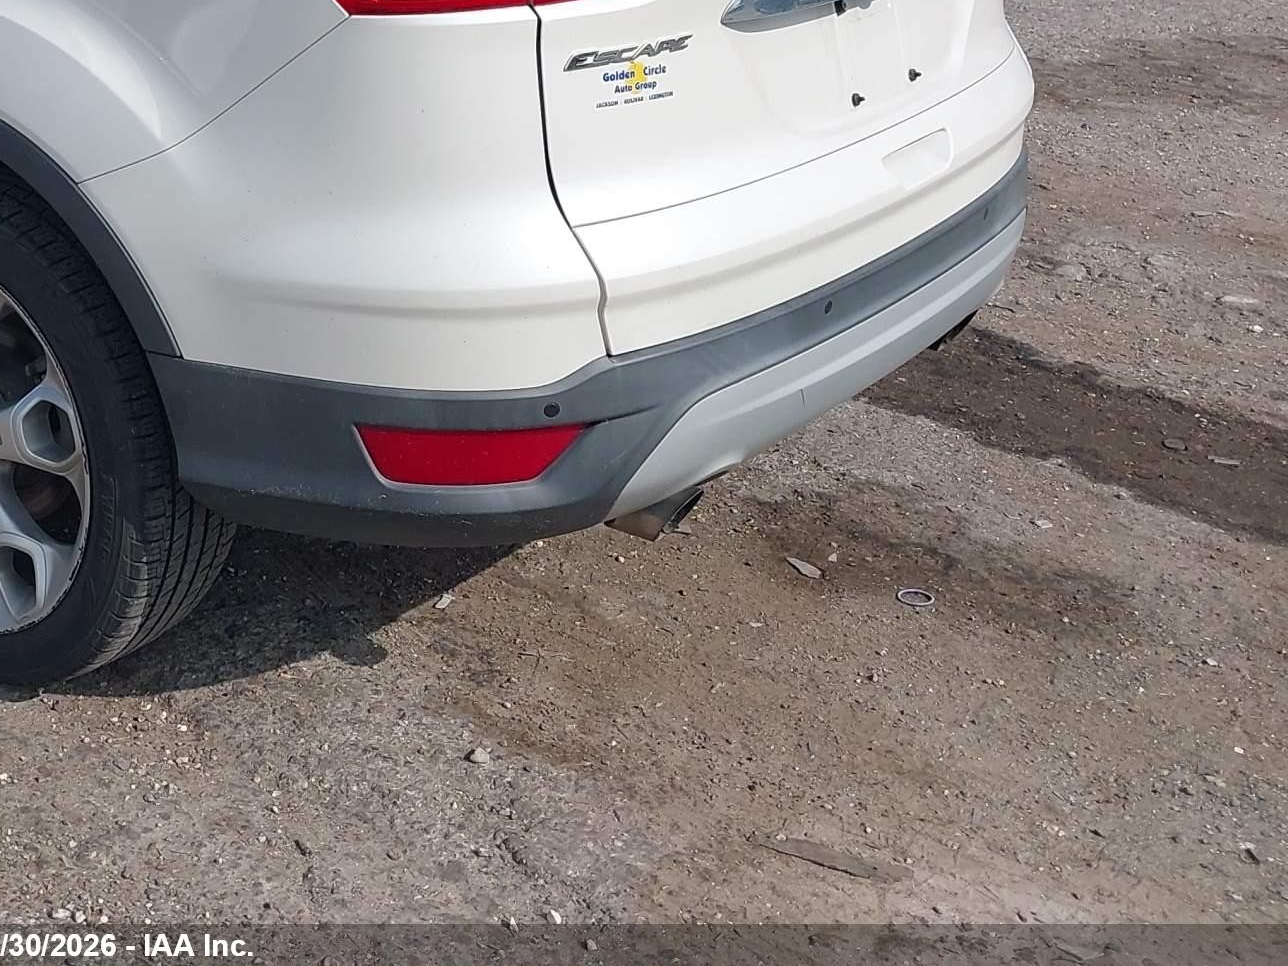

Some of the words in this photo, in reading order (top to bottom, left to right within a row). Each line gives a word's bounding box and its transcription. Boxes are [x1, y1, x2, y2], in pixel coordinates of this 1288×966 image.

[563, 34, 694, 72] ESCAPE
[602, 70, 636, 82] Golden
[643, 64, 667, 76] Circle
[614, 85, 633, 94] Auto
[635, 81, 657, 90] Group
